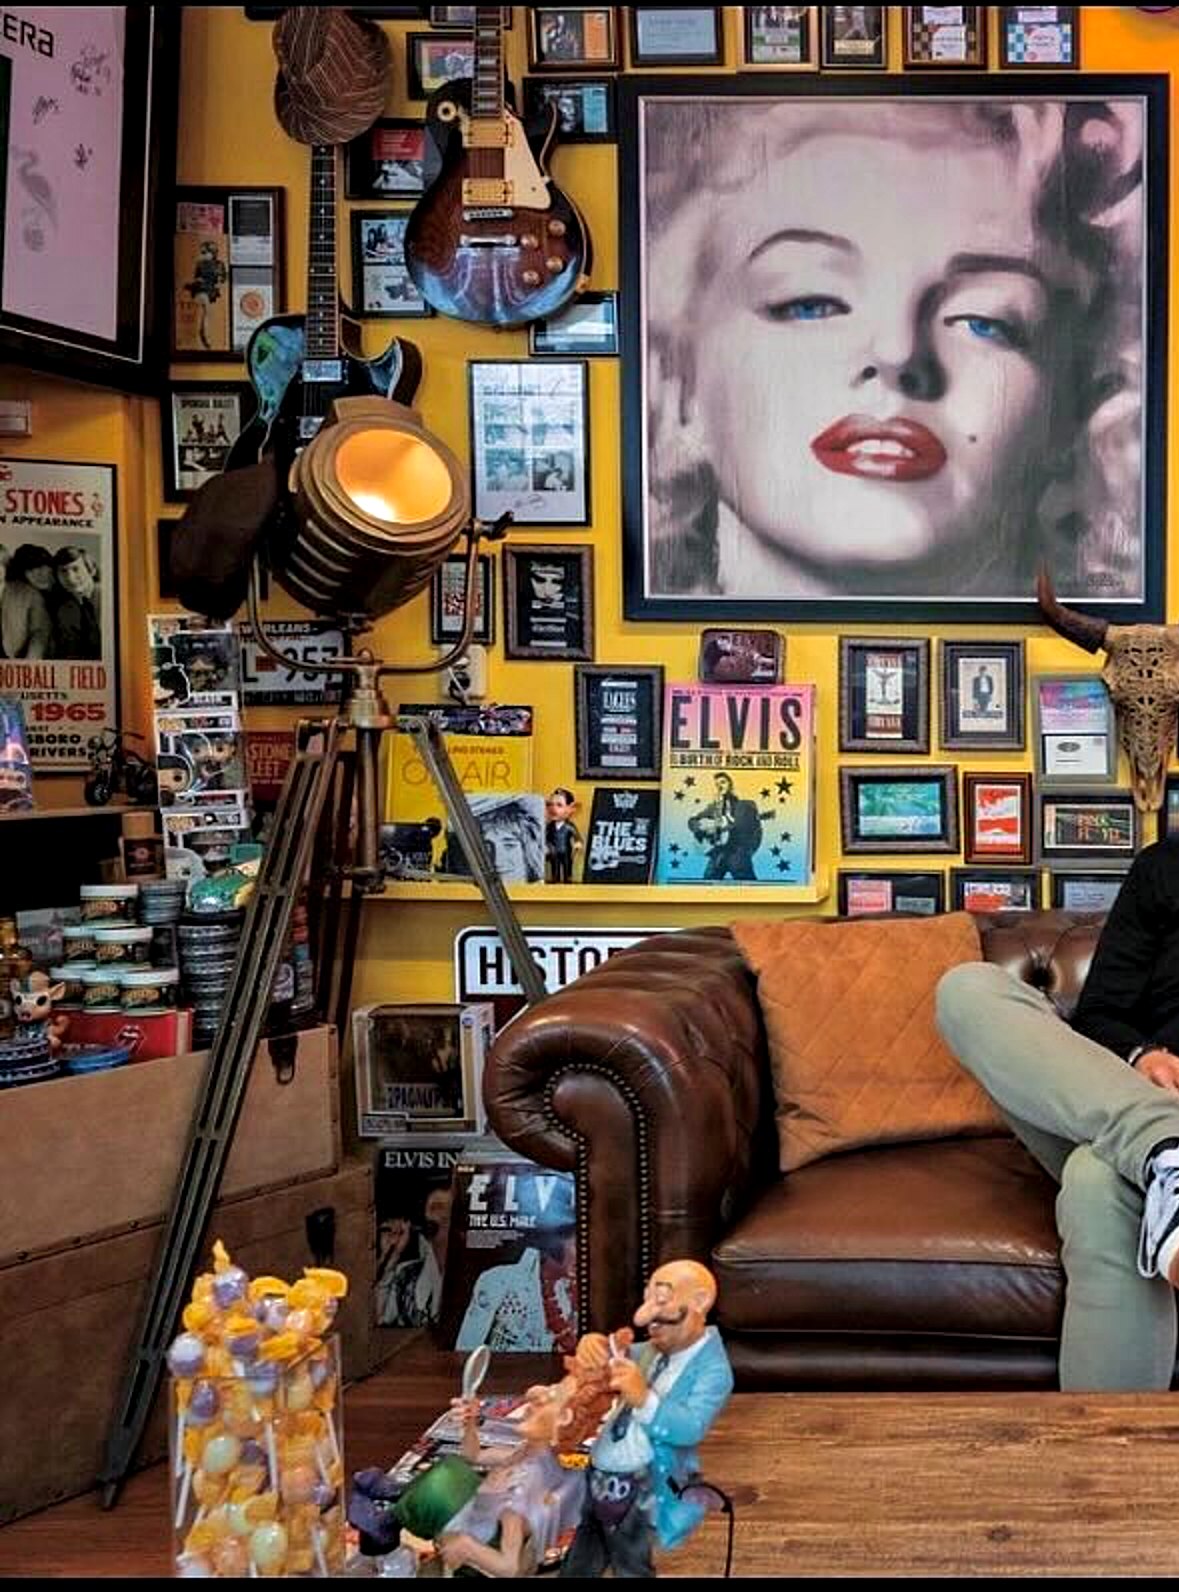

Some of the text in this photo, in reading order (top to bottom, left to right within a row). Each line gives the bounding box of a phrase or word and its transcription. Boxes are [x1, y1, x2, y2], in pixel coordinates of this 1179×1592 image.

[5, 489, 85, 516] STONES
[12, 516, 95, 528] APPEARANCE
[263, 622, 312, 636] RLEANS
[31, 702, 107, 722] 1965
[671, 695, 802, 751] ELVIS
[461, 760, 513, 789] AIR
[595, 821, 633, 837] THE
[592, 836, 647, 851] BLUES
[384, 1151, 459, 1169] ELVIS IN
[468, 1213, 488, 1228] THE
